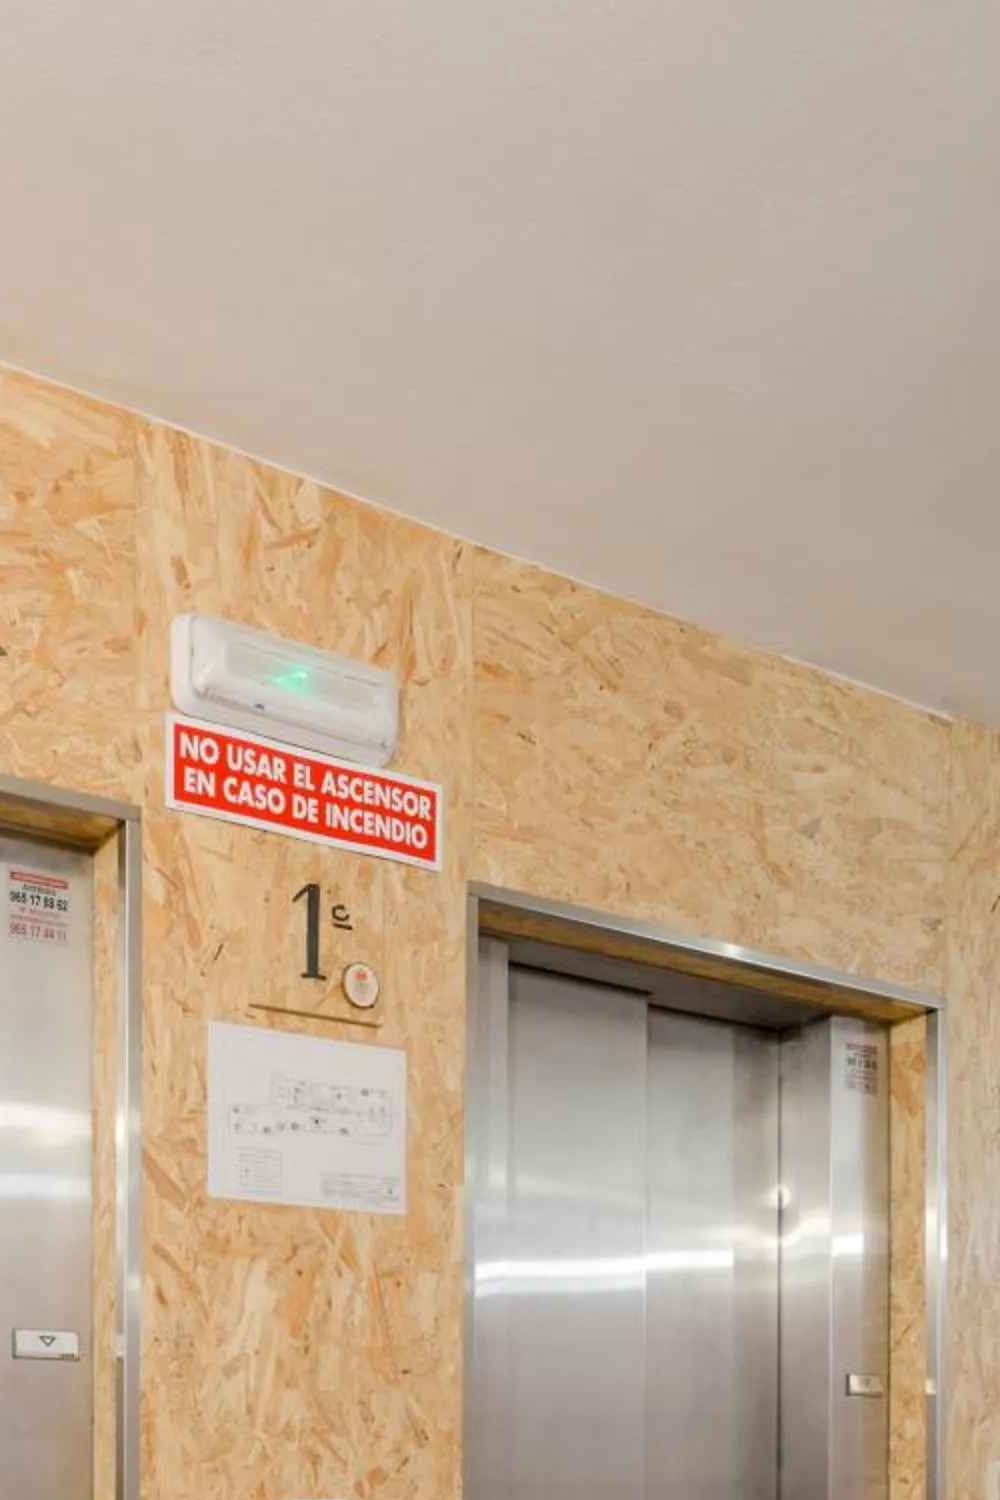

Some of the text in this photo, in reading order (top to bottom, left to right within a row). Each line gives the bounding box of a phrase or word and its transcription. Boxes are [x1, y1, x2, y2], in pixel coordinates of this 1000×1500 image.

[180, 732, 431, 820] NO USAR EL ASCENSOR
[184, 767, 428, 849] EN CASO DE INCENDIO
